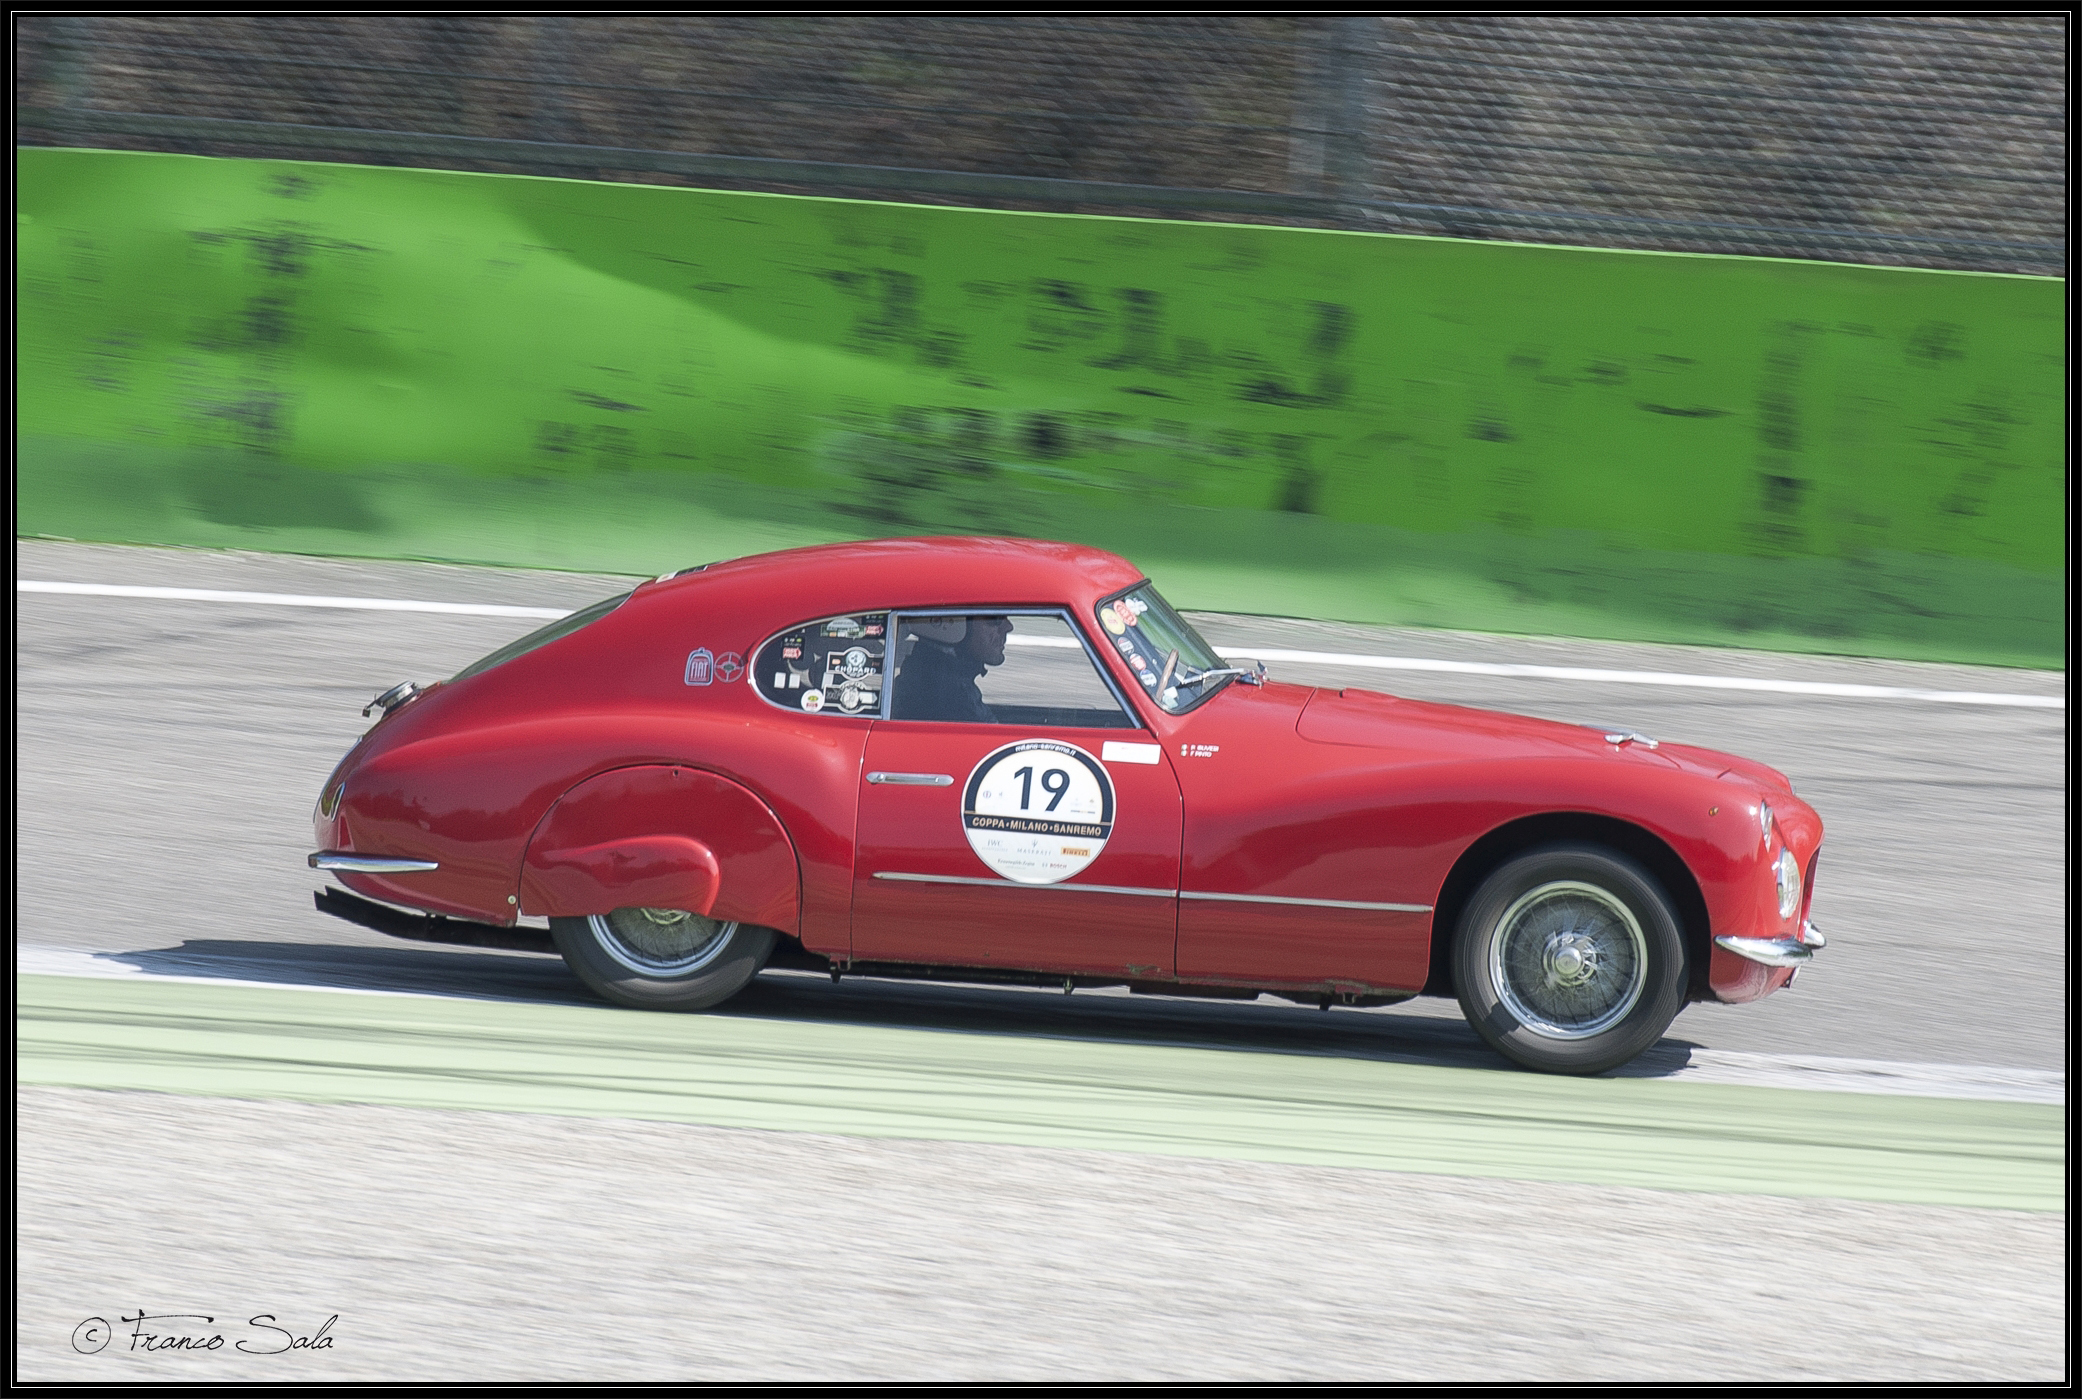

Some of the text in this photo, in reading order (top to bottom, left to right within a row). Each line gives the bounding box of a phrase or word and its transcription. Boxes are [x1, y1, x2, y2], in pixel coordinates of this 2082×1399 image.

[690, 661, 708, 679] FIAT
[834, 665, 877, 674] CHOPARD
[1013, 766, 1071, 812] 19
[972, 816, 1102, 837] COPPA MILANO SANREMO
